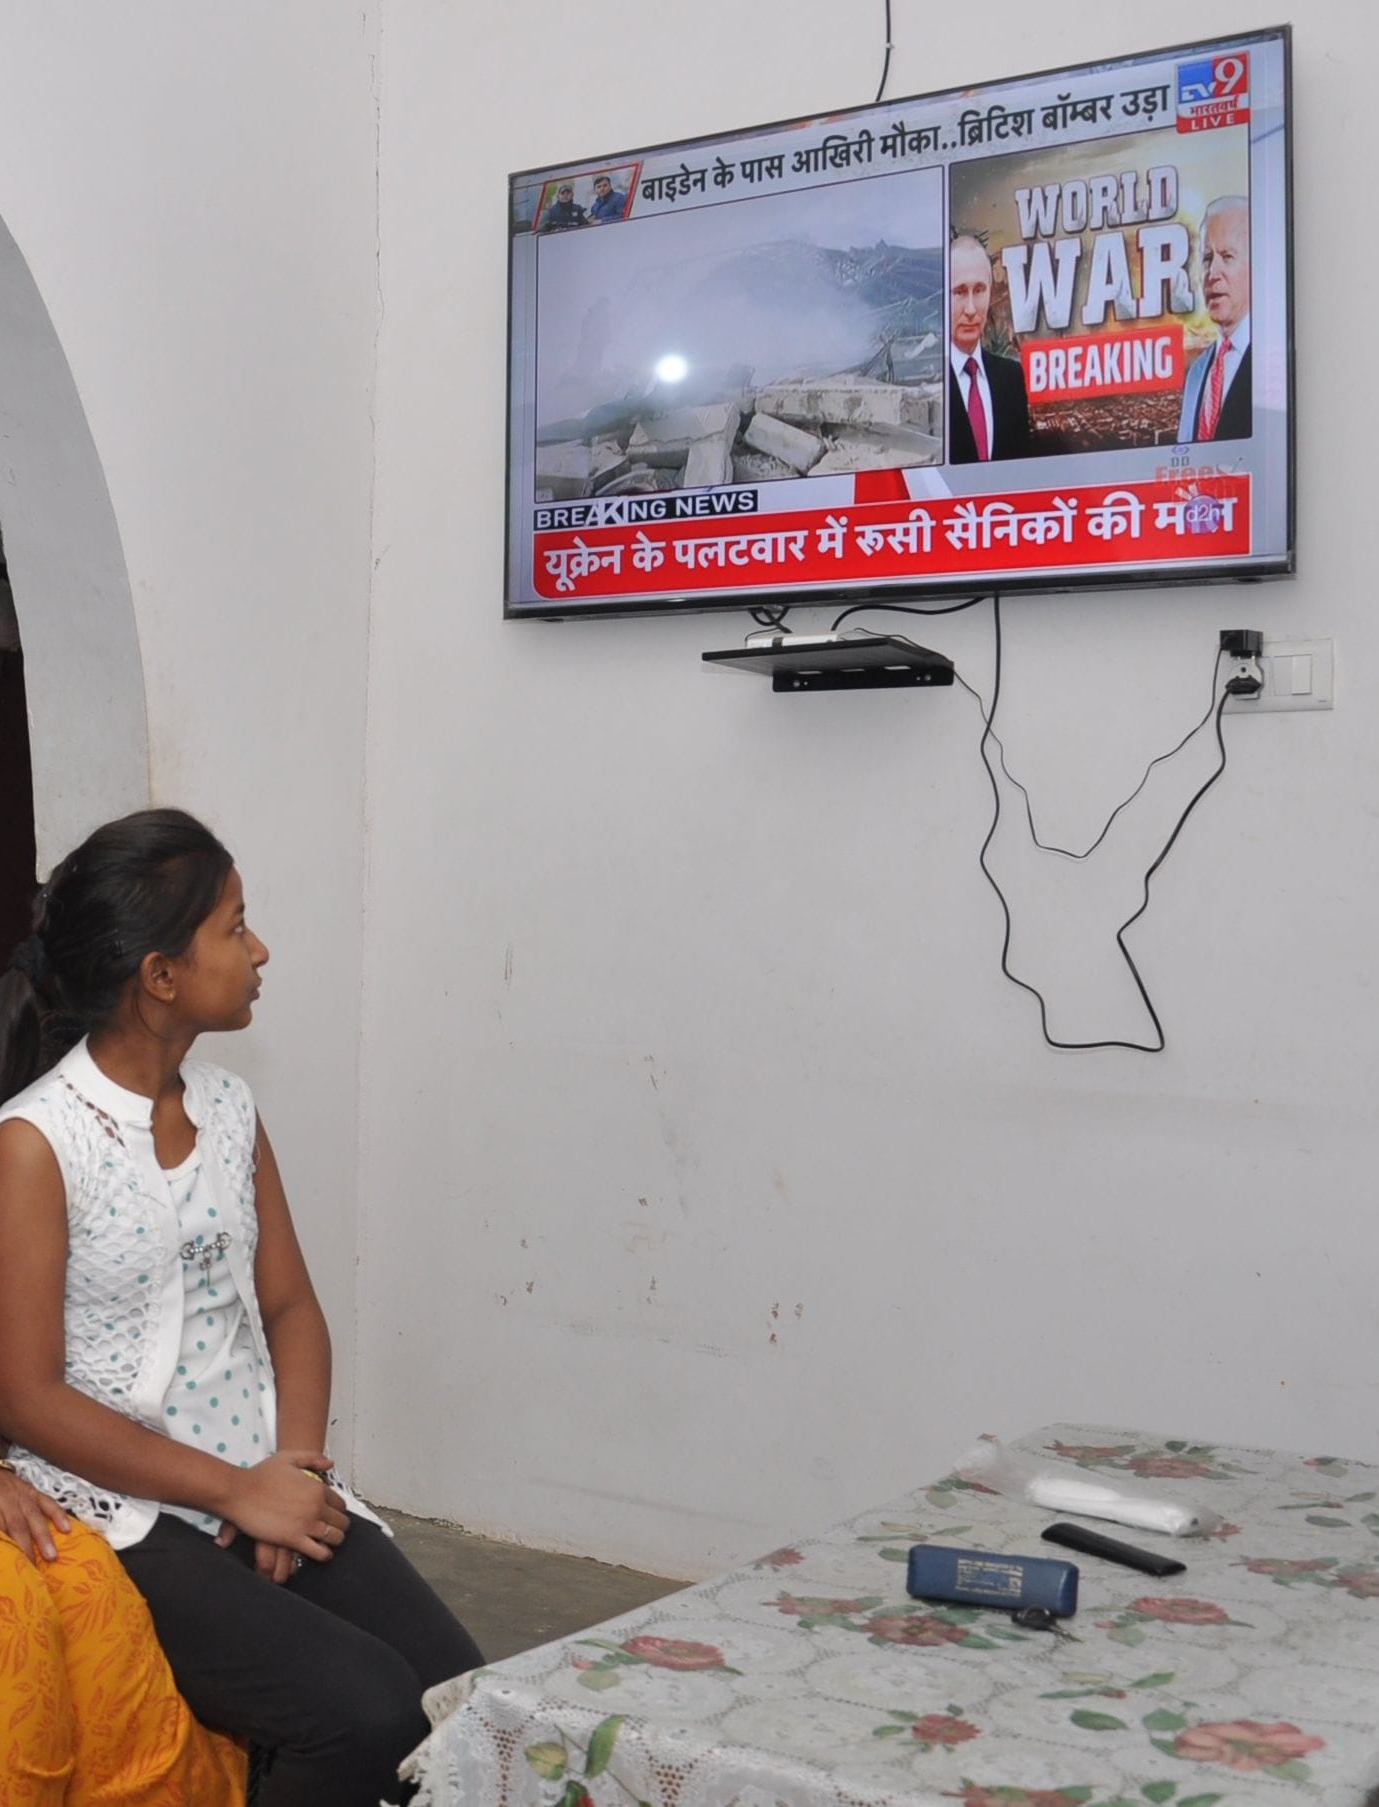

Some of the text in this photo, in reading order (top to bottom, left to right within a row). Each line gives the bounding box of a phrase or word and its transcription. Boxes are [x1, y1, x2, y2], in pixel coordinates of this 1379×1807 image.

[641, 163, 708, 203] बाइडेन
[713, 156, 735, 188] के
[740, 153, 785, 184] पास
[791, 129, 875, 174] आखिरी
[1041, 93, 1115, 130] बॉम्बर
[1120, 83, 1170, 122] उड़ा
[1191, 113, 1235, 131] LIVE
[1015, 165, 1179, 239] WORLD
[1002, 222, 1196, 334] WAR
[1029, 336, 1173, 394] BREAKING
[536, 491, 755, 528] BREAKING NEWS
[544, 535, 624, 592] यूक्रेन
[631, 530, 666, 572] के
[673, 529, 808, 569] पलटवार
[816, 515, 848, 559] में
[854, 509, 936, 556] रूसी
[943, 497, 1078, 550] सैनिकों
[1086, 491, 1145, 540] की
[1186, 503, 1220, 523] d2h
